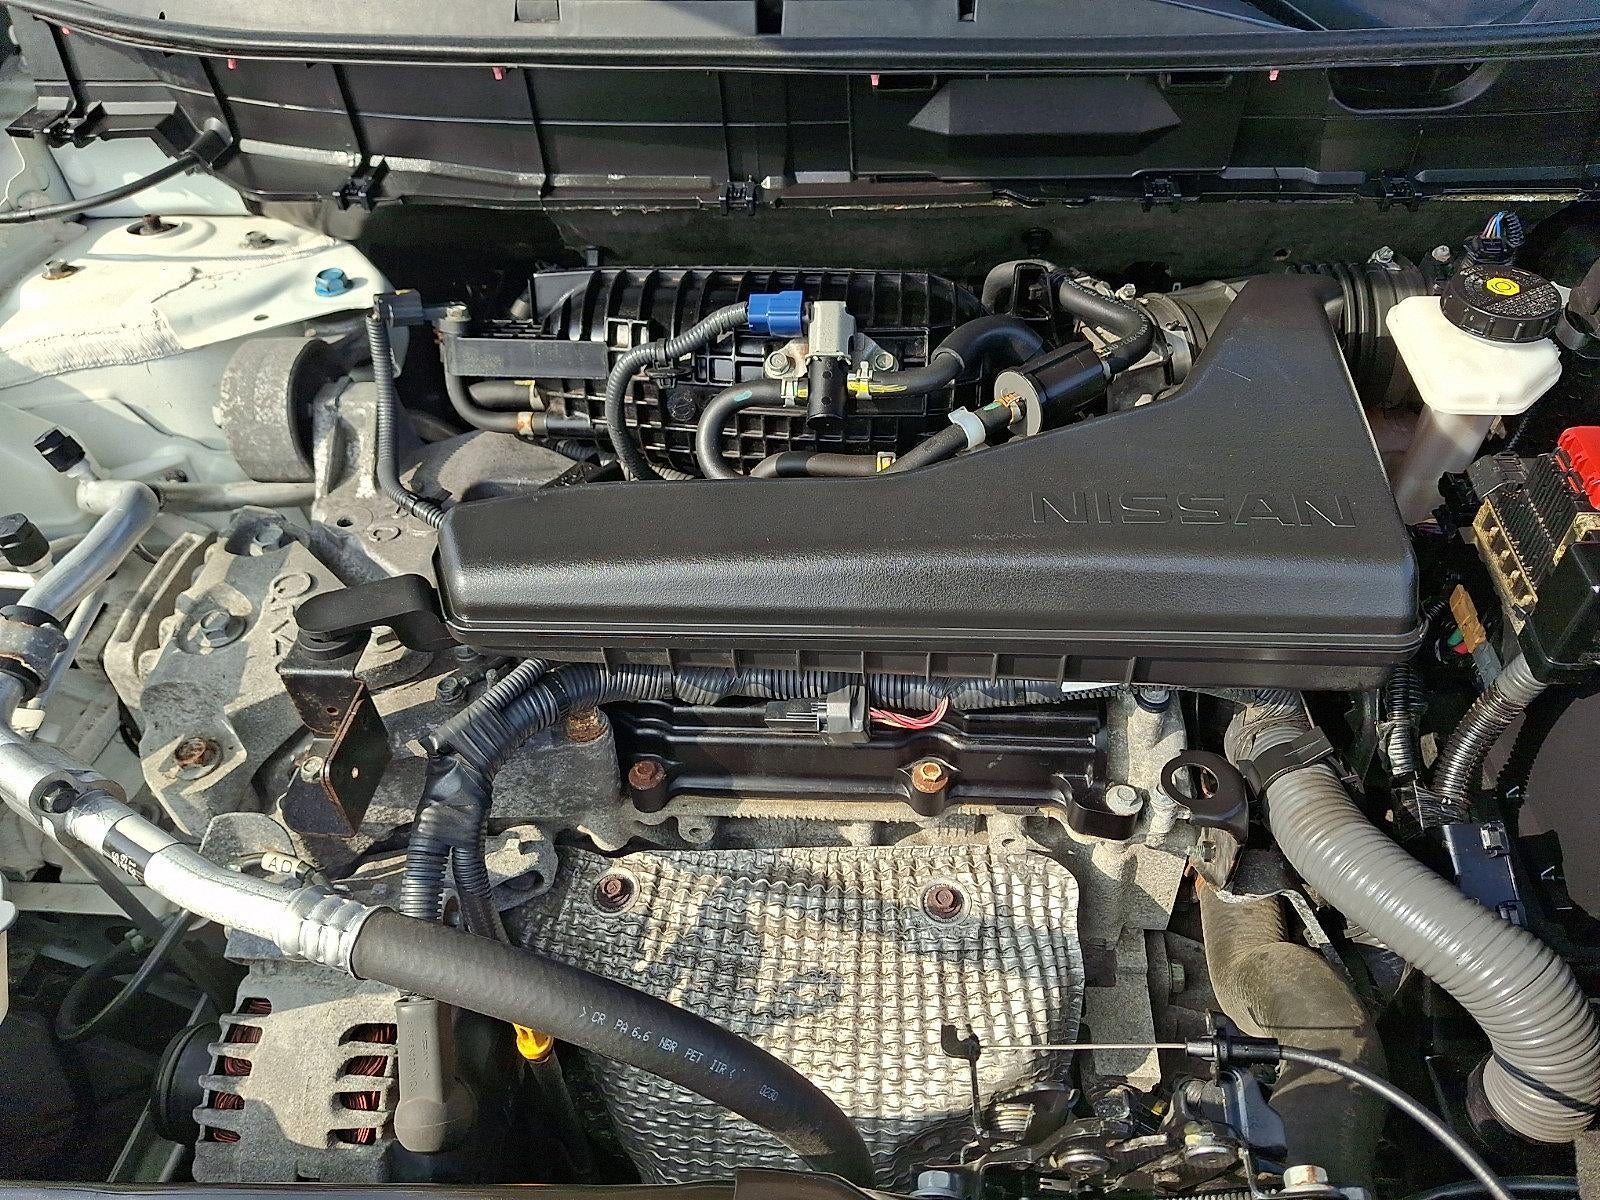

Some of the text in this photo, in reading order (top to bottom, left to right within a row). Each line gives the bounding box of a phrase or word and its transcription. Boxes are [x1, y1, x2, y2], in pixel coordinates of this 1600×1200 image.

[1029, 489, 1357, 529] NISSAN
[591, 1011, 606, 1026] CR
[613, 1018, 629, 1034] PA
[658, 1036, 678, 1053] NBR
[684, 1047, 704, 1064] PET
